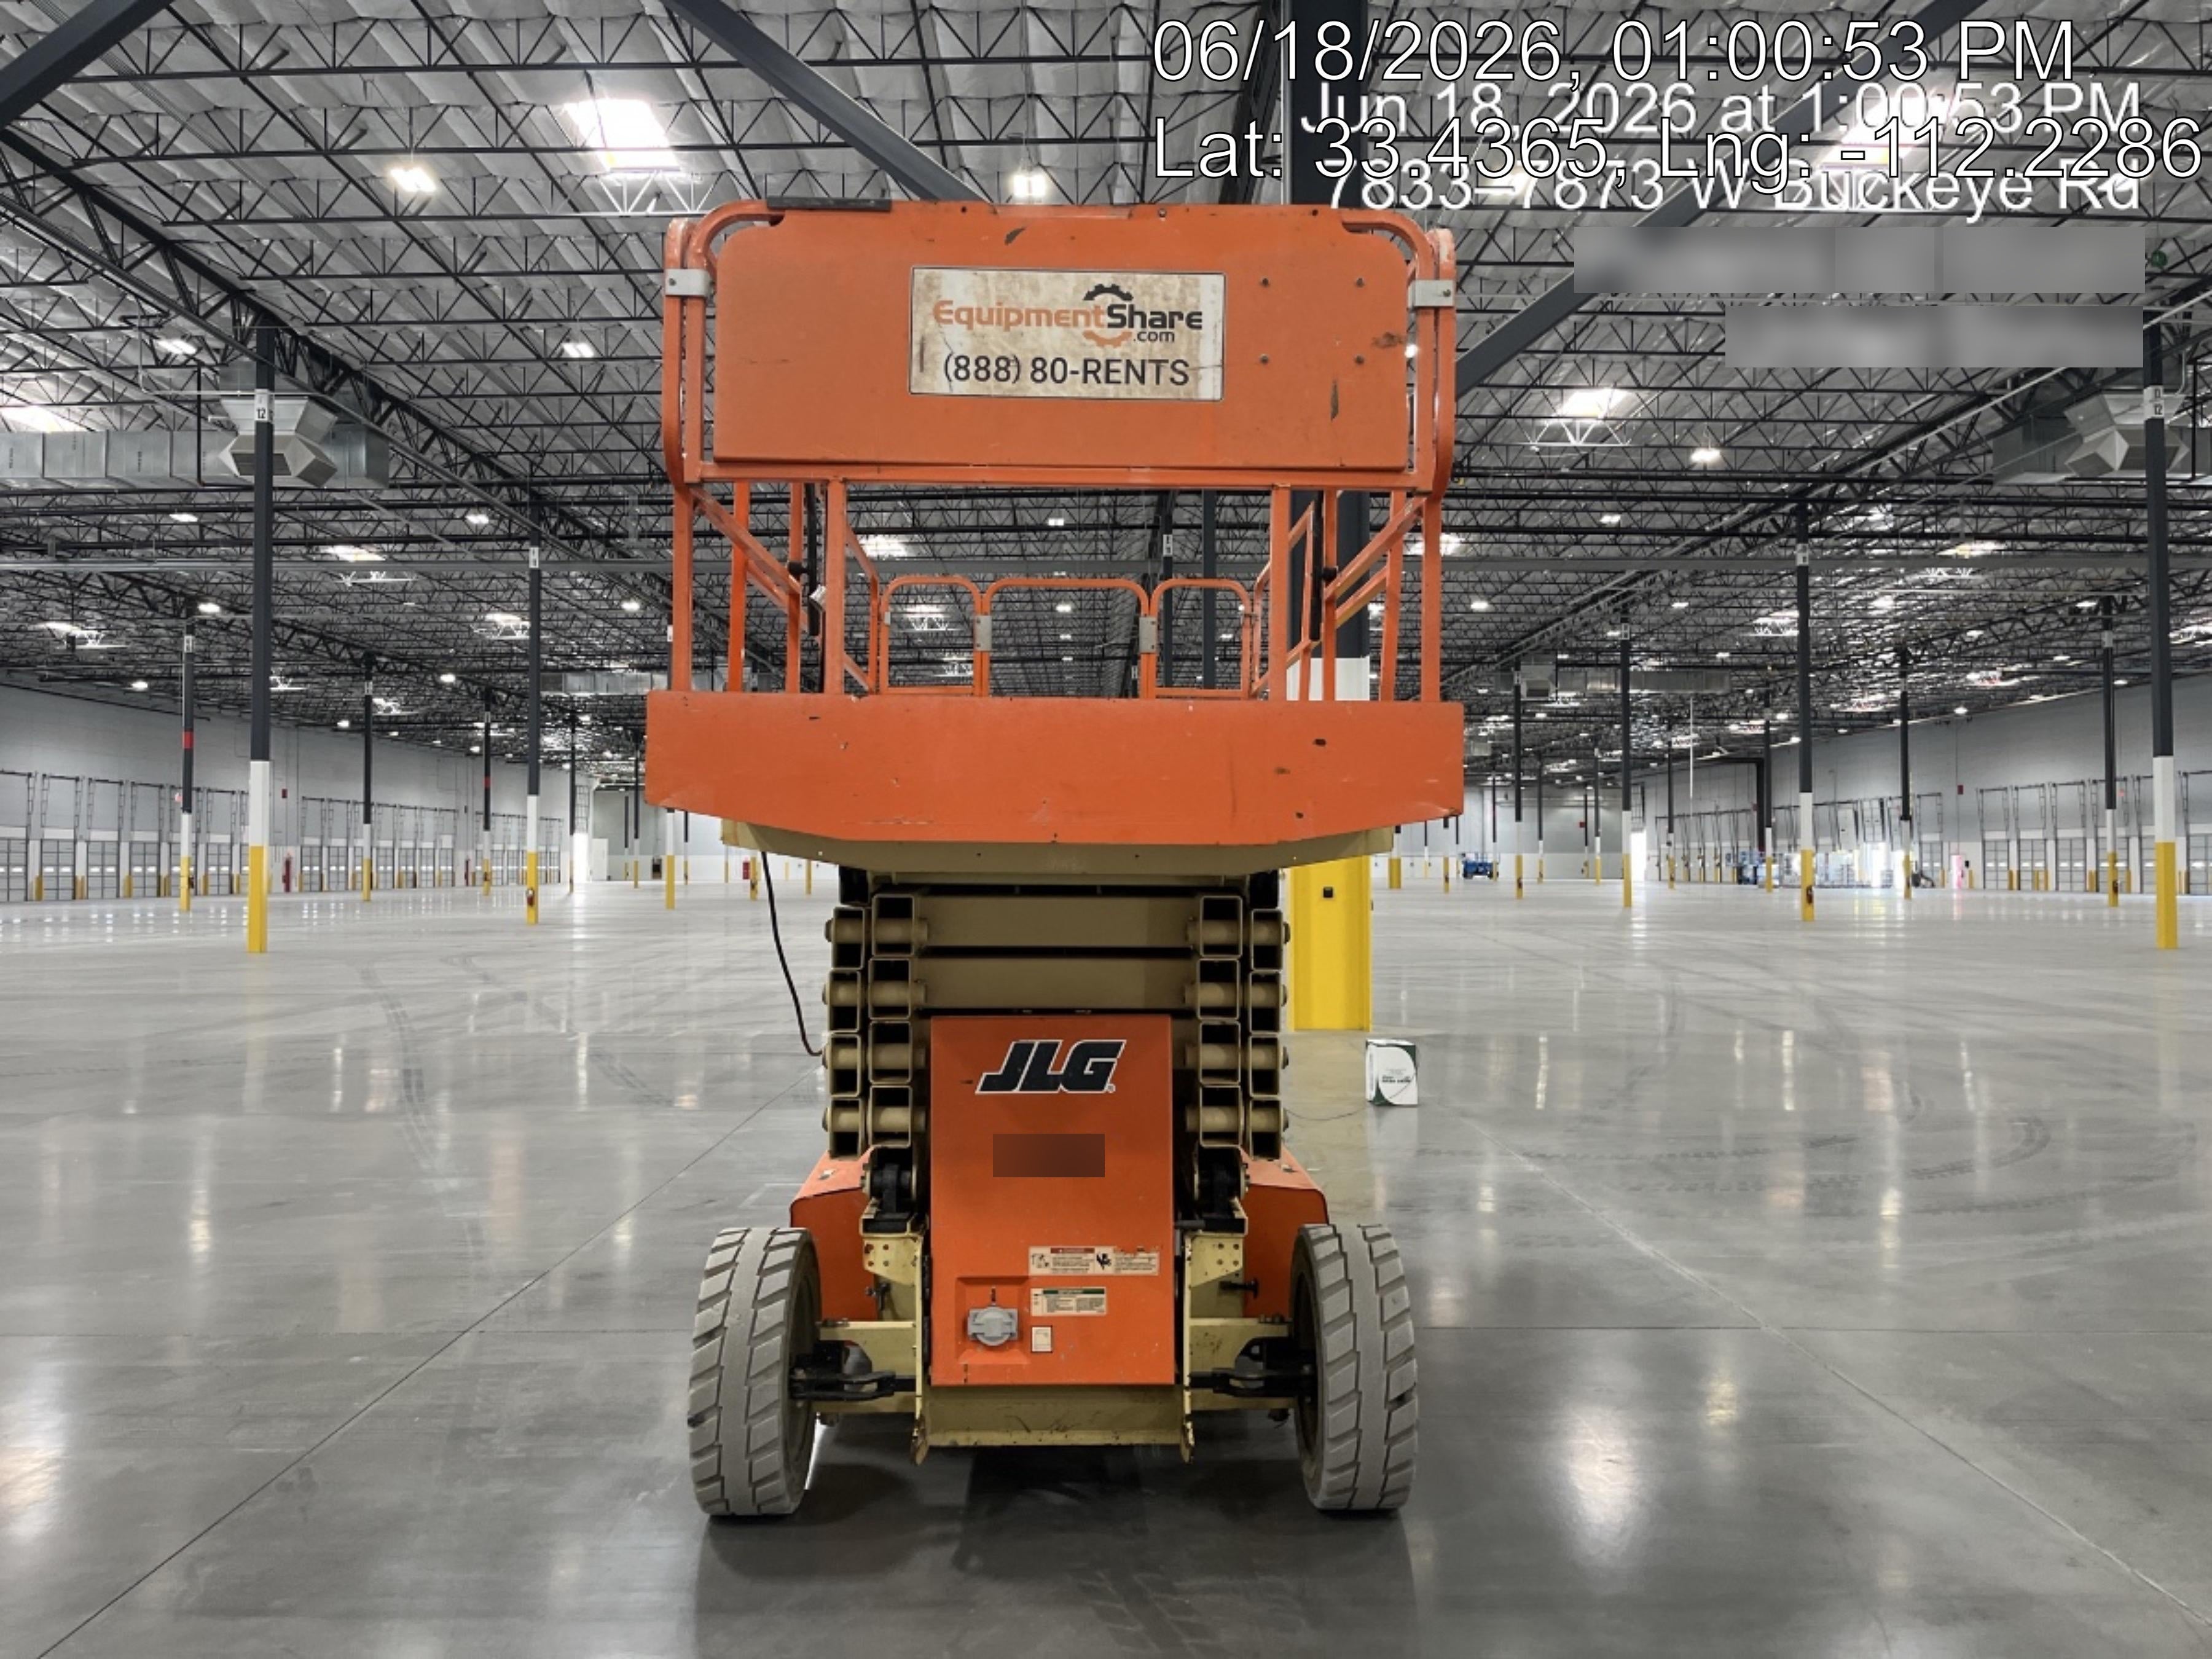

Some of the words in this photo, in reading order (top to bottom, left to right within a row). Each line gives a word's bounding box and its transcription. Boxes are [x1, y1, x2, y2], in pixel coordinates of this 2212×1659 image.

[933, 300, 1202, 331] EquipmentShare
[1133, 331, 1175, 343] .com
[944, 353, 1020, 384] (888)
[1030, 357, 1190, 386] 80-RENTS
[255, 407, 266, 419] 12
[975, 1039, 1127, 1095] JLG
